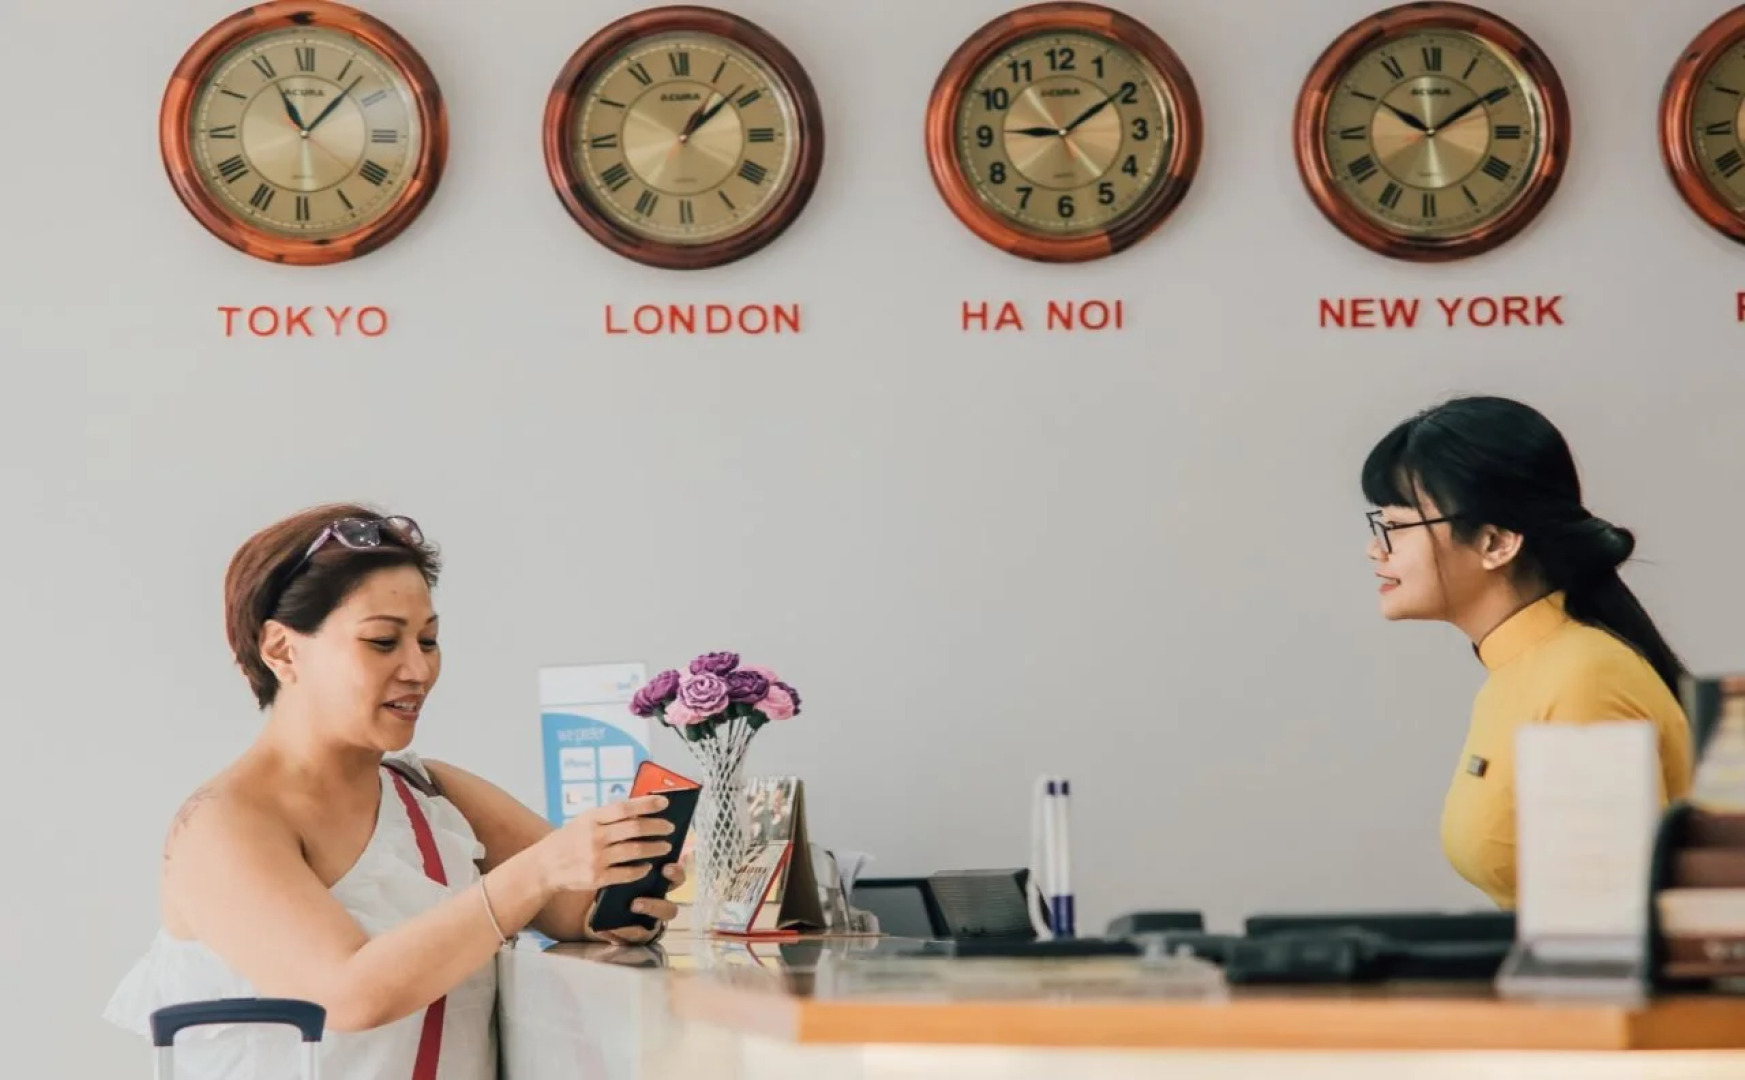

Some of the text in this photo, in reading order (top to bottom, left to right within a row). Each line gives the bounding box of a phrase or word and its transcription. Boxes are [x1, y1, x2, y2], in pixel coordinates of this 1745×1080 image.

[1045, 48, 1074, 70] 12
[1092, 56, 1103, 78] 1
[1008, 60, 1032, 82] 11
[981, 88, 1008, 110] 10
[1119, 82, 1137, 104] 2
[372, 130, 397, 143] III
[749, 128, 773, 142] III
[977, 126, 993, 148] 9
[1132, 118, 1148, 140] 3
[1495, 126, 1520, 139] III
[990, 162, 1006, 184] 8
[1122, 155, 1137, 176] 4
[1017, 187, 1032, 209] 7
[1099, 183, 1114, 205] 5
[1058, 196, 1074, 218] 6
[218, 306, 388, 337] TOKYO
[605, 304, 801, 335] LONDON
[961, 300, 1123, 331] HA NOI
[1319, 296, 1564, 328] NEW YORK
